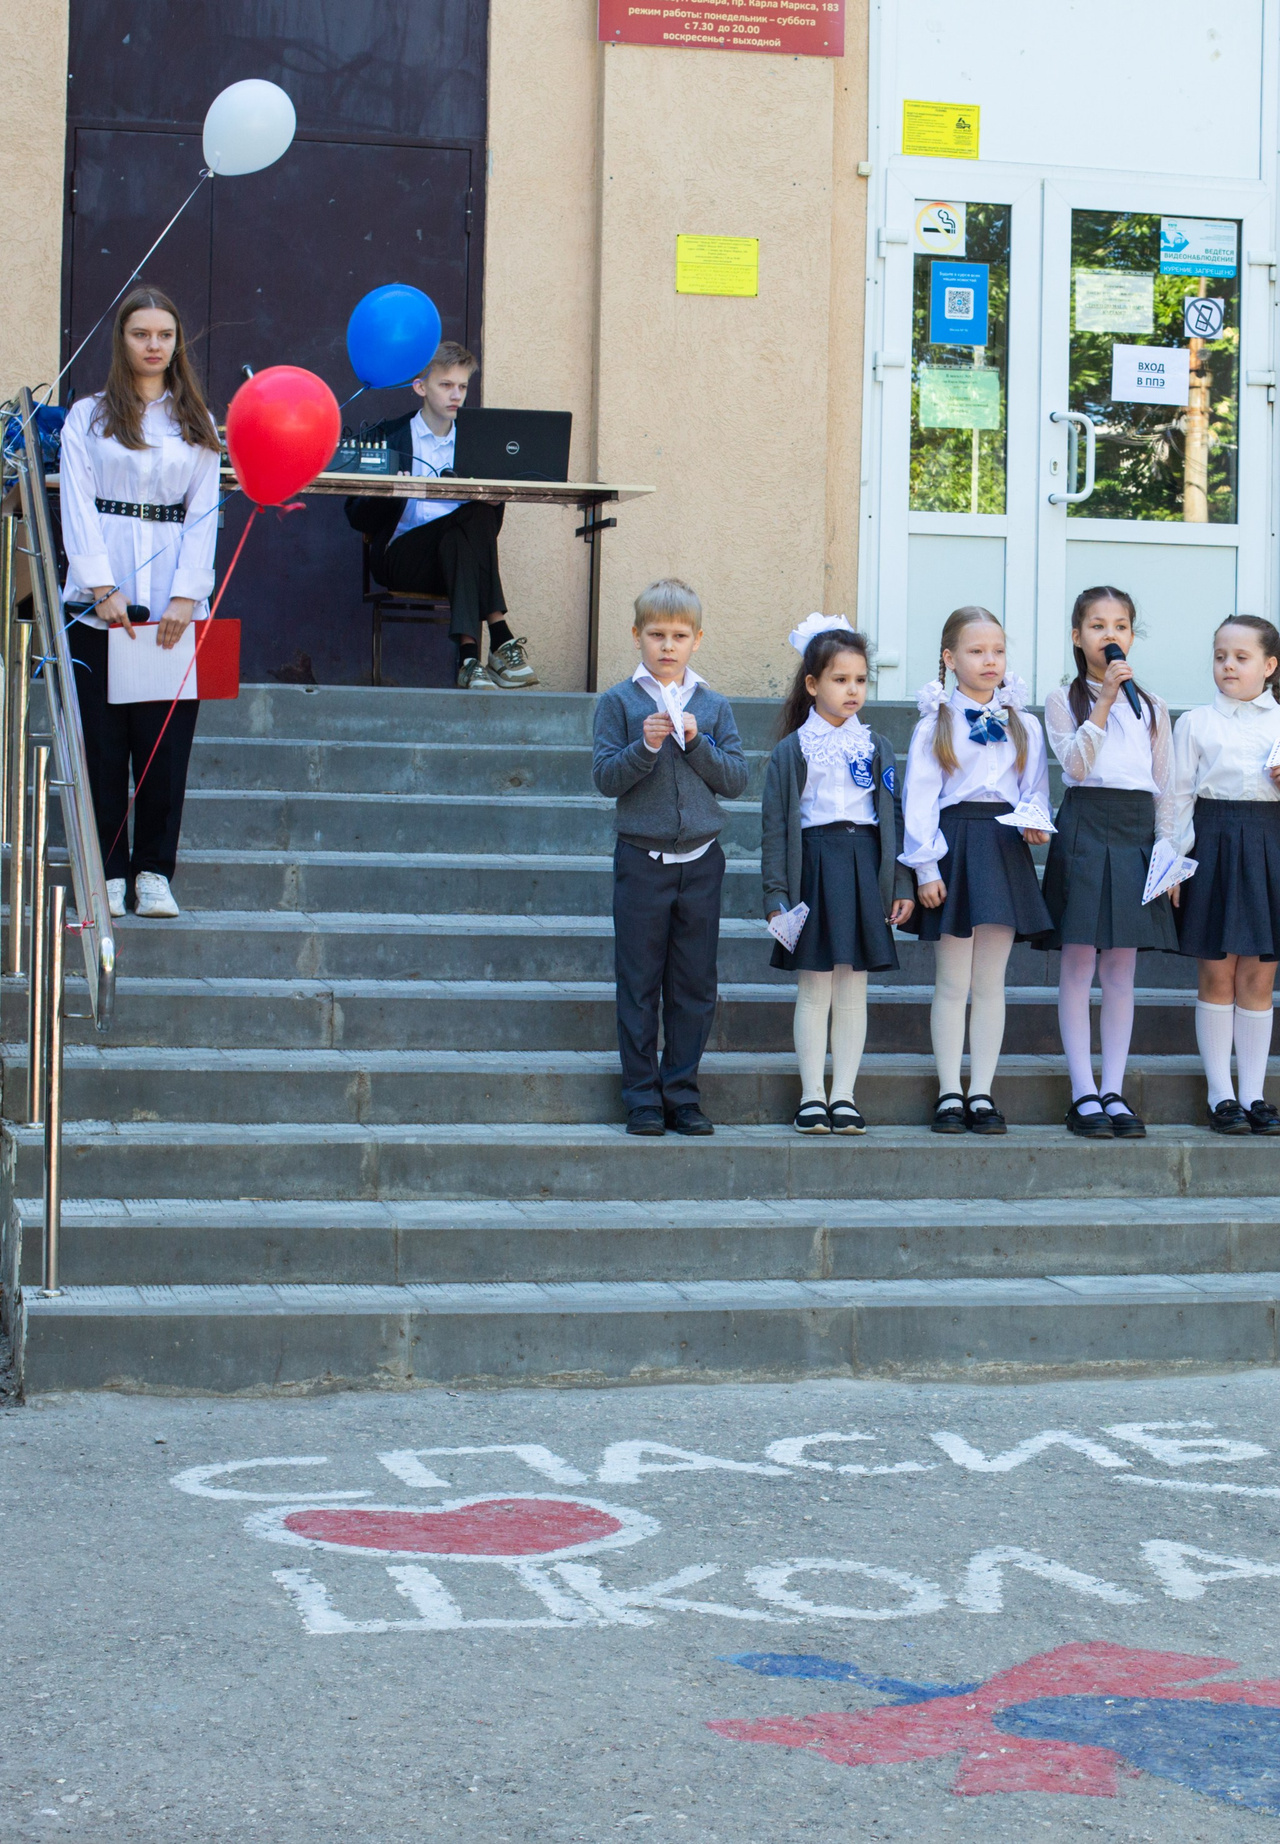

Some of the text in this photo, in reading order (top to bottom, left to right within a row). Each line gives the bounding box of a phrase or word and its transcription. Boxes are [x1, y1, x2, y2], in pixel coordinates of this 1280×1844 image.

[748, 0, 778, 8] Карла
[780, 2, 818, 11] Маркса,
[822, 3, 839, 12] 183
[628, 7, 661, 16] режим
[663, 8, 702, 18] работы:
[704, 12, 768, 23] понедельник
[777, 16, 816, 26] суббота
[692, 22, 714, 31] 7.30
[718, 25, 730, 33] до
[732, 24, 760, 34] 20.00
[663, 33, 725, 43] воскресенье
[733, 37, 781, 46] выходной
[1164, 253, 1234, 262] ВИДЕОНАБЛЮДЕНИЕ
[1204, 248, 1234, 256] ВЕДЁТСЯ
[1195, 268, 1234, 276] ЗАПРЕЩЕНО
[1138, 362, 1165, 374] ВХОД
[1137, 377, 1165, 387] В ППЭ
